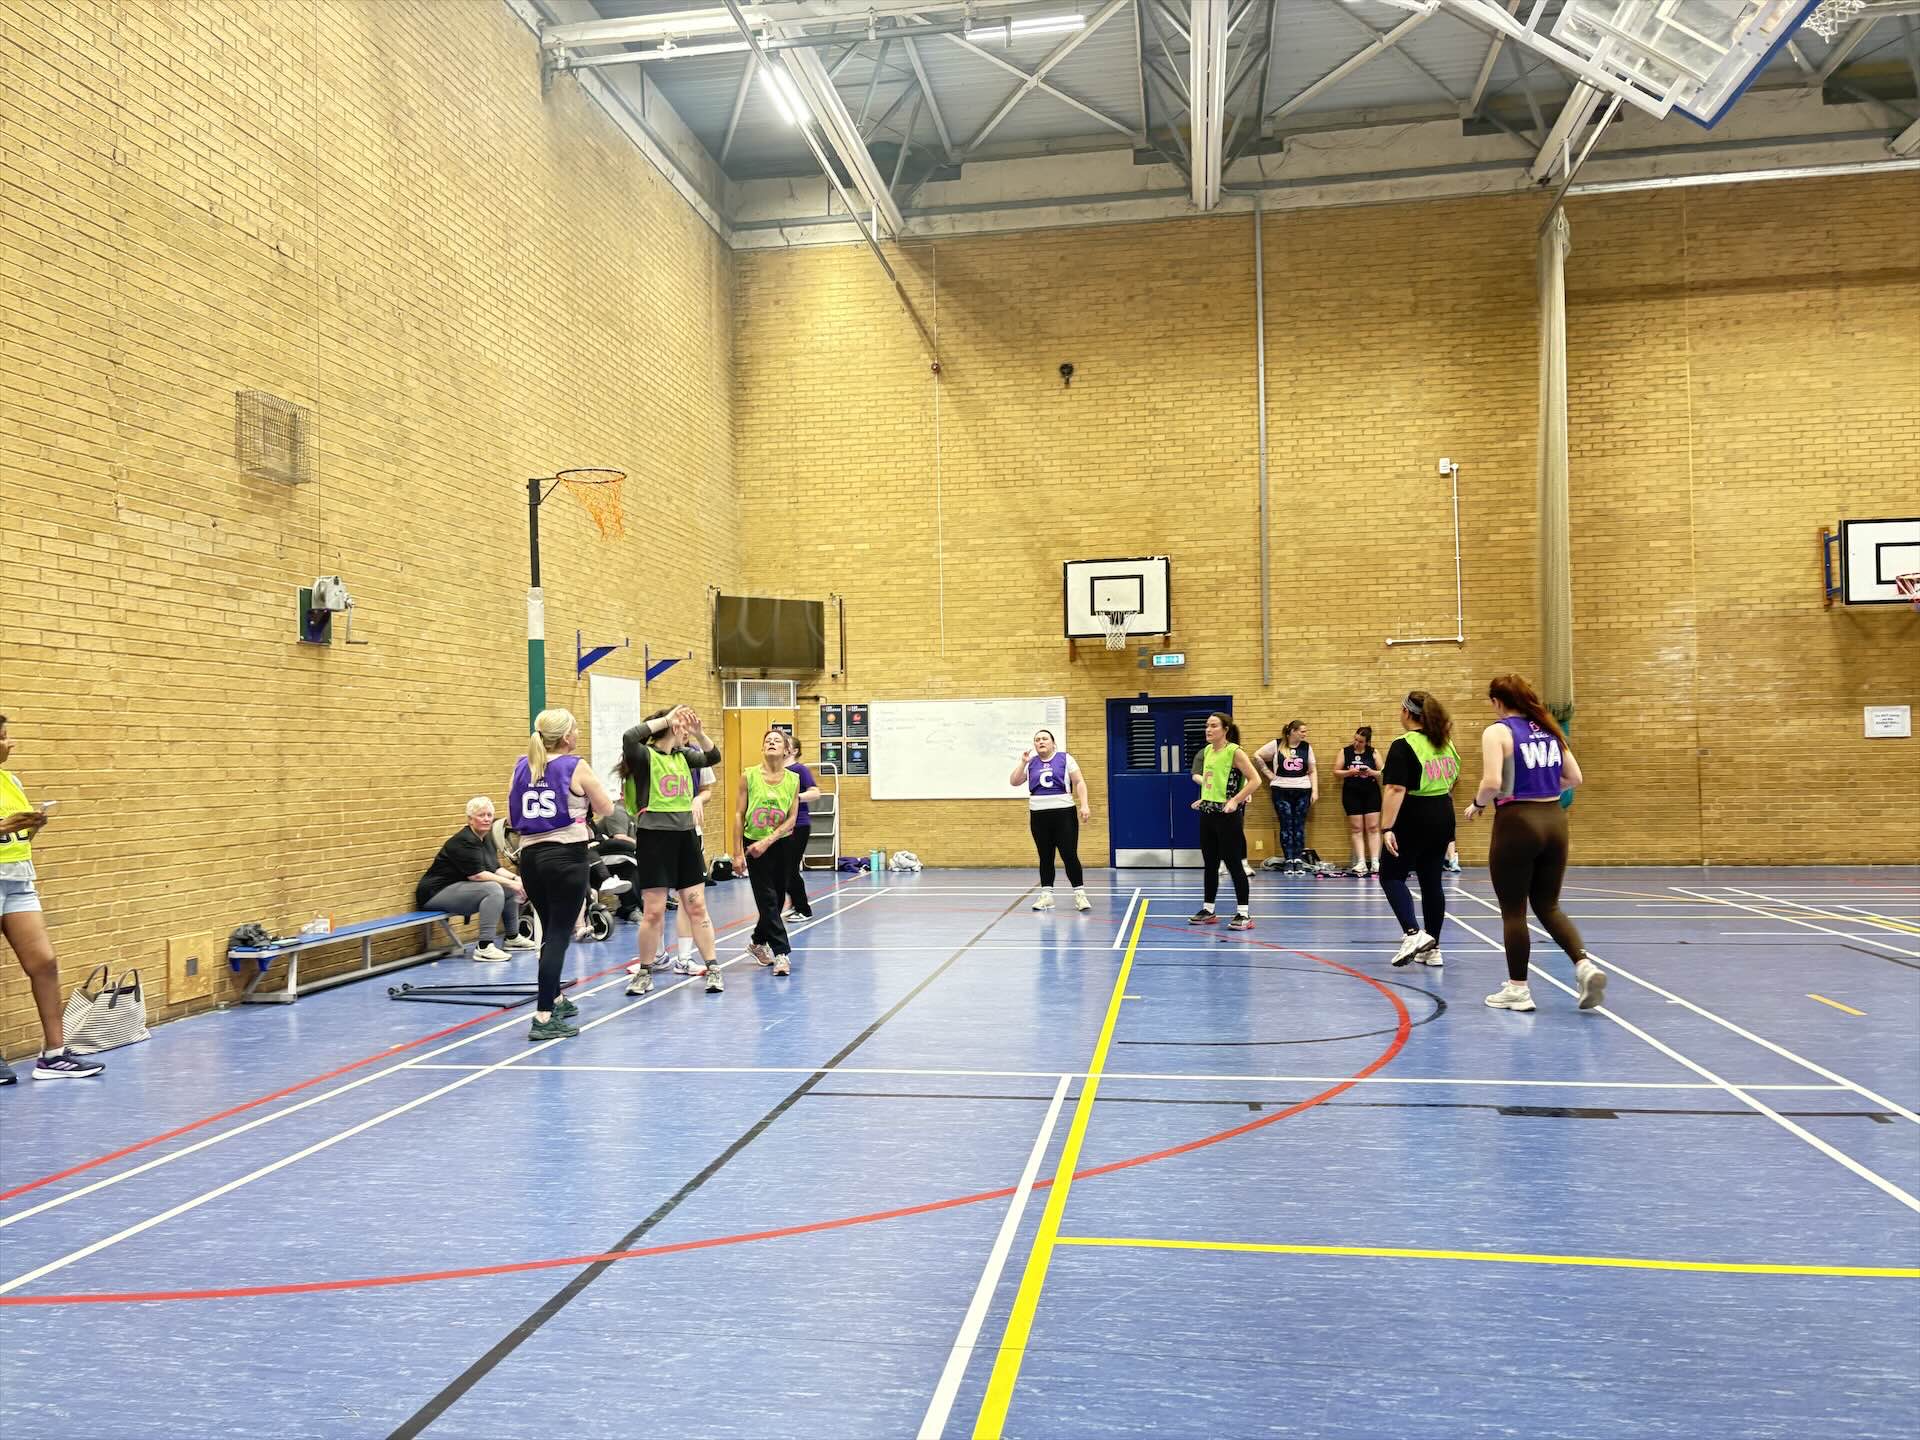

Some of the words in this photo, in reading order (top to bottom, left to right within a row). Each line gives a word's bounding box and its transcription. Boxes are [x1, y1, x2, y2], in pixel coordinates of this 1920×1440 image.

[1283, 757, 1303, 771] GS
[1519, 739, 1562, 770] WA
[1039, 771, 1054, 788] C
[521, 789, 558, 819] GS
[752, 807, 786, 829] GD
